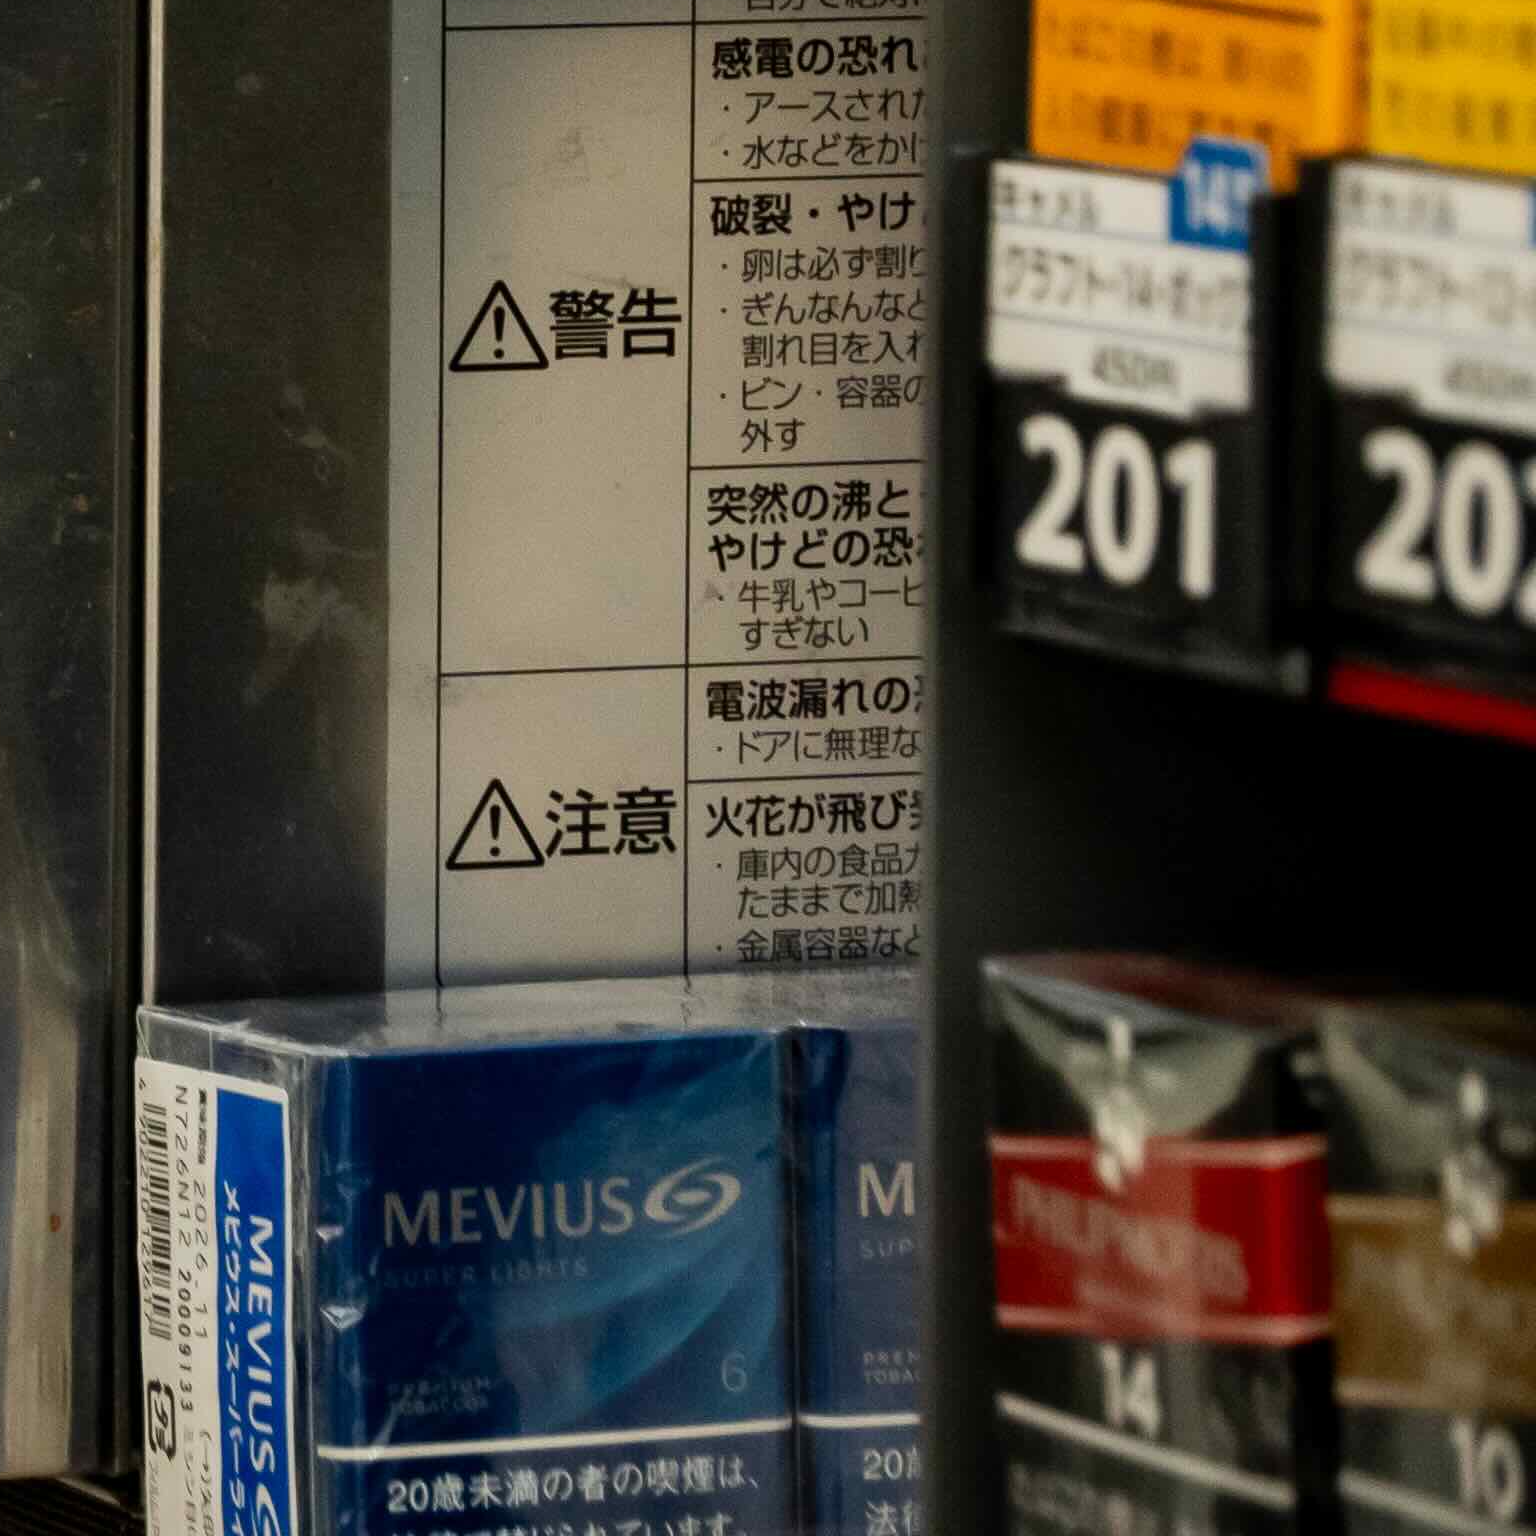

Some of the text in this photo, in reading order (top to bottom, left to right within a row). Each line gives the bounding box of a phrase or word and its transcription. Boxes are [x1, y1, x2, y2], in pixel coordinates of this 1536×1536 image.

[712, 35, 918, 79] 感電の恐れ
[710, 191, 916, 236] 破裂・やけ
[550, 286, 681, 360] 警告
[740, 416, 806, 454] 外す
[1015, 413, 1216, 600] 201
[742, 616, 869, 651] すぎない
[707, 676, 924, 722] 電波漏れの
[545, 787, 676, 859] 注意
[383, 1176, 632, 1248] MEVIUS
[247, 1215, 278, 1473] MEVIUS
[721, 1350, 747, 1393] 6
[387, 1456, 761, 1514] 20歳未満の者の喫煙は、
[1450, 1418, 1524, 1524] 10
